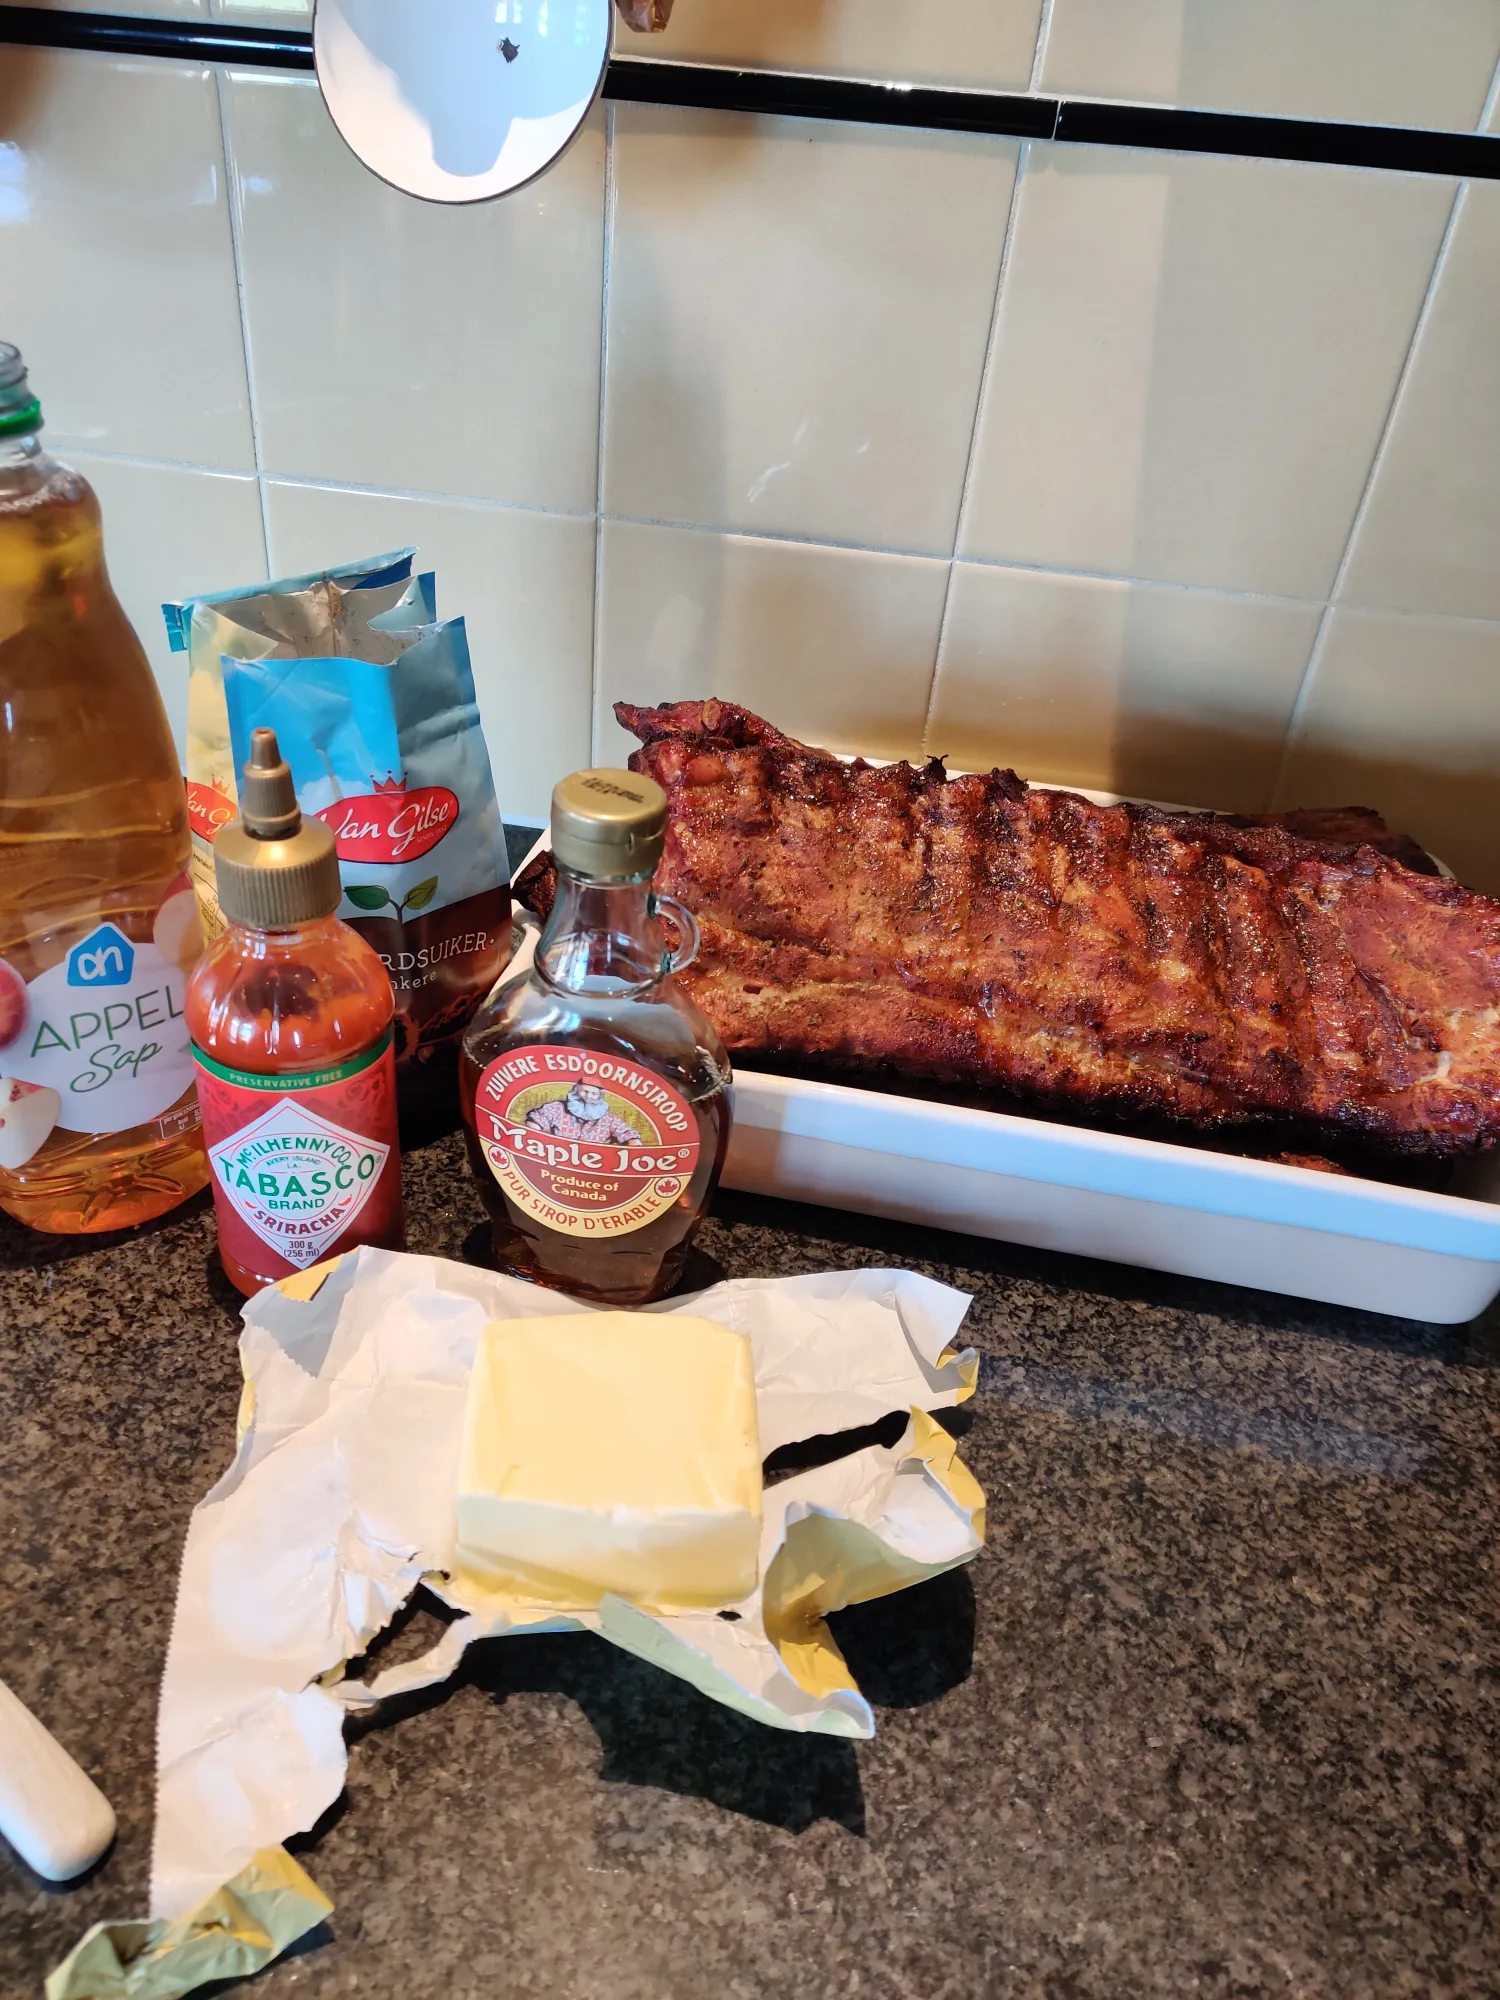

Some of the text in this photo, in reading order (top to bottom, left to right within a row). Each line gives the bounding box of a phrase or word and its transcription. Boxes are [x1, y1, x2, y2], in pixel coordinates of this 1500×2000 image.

[387, 796, 450, 856] Gilse
[378, 931, 487, 971] RDSUIKER
[390, 970, 438, 990] nkere
[30, 985, 183, 1058] APPEL
[69, 1041, 164, 1093] Sap
[229, 1070, 343, 1088] PRESERVATIVE FREE
[485, 1053, 689, 1133] ZUIVERE ESDOORNSIROOP
[489, 1115, 603, 1169] Maple
[218, 1153, 375, 1198] TABASCO
[540, 1169, 620, 1193] Produce of
[551, 1183, 608, 1202] Canada
[268, 1198, 325, 1210] BRAND
[503, 1170, 662, 1230] PUR SIROP D'ERABLE
[253, 1206, 346, 1235] SRIRACHA
[283, 1249, 304, 1258] (256
[288, 1240, 305, 1250] 300
